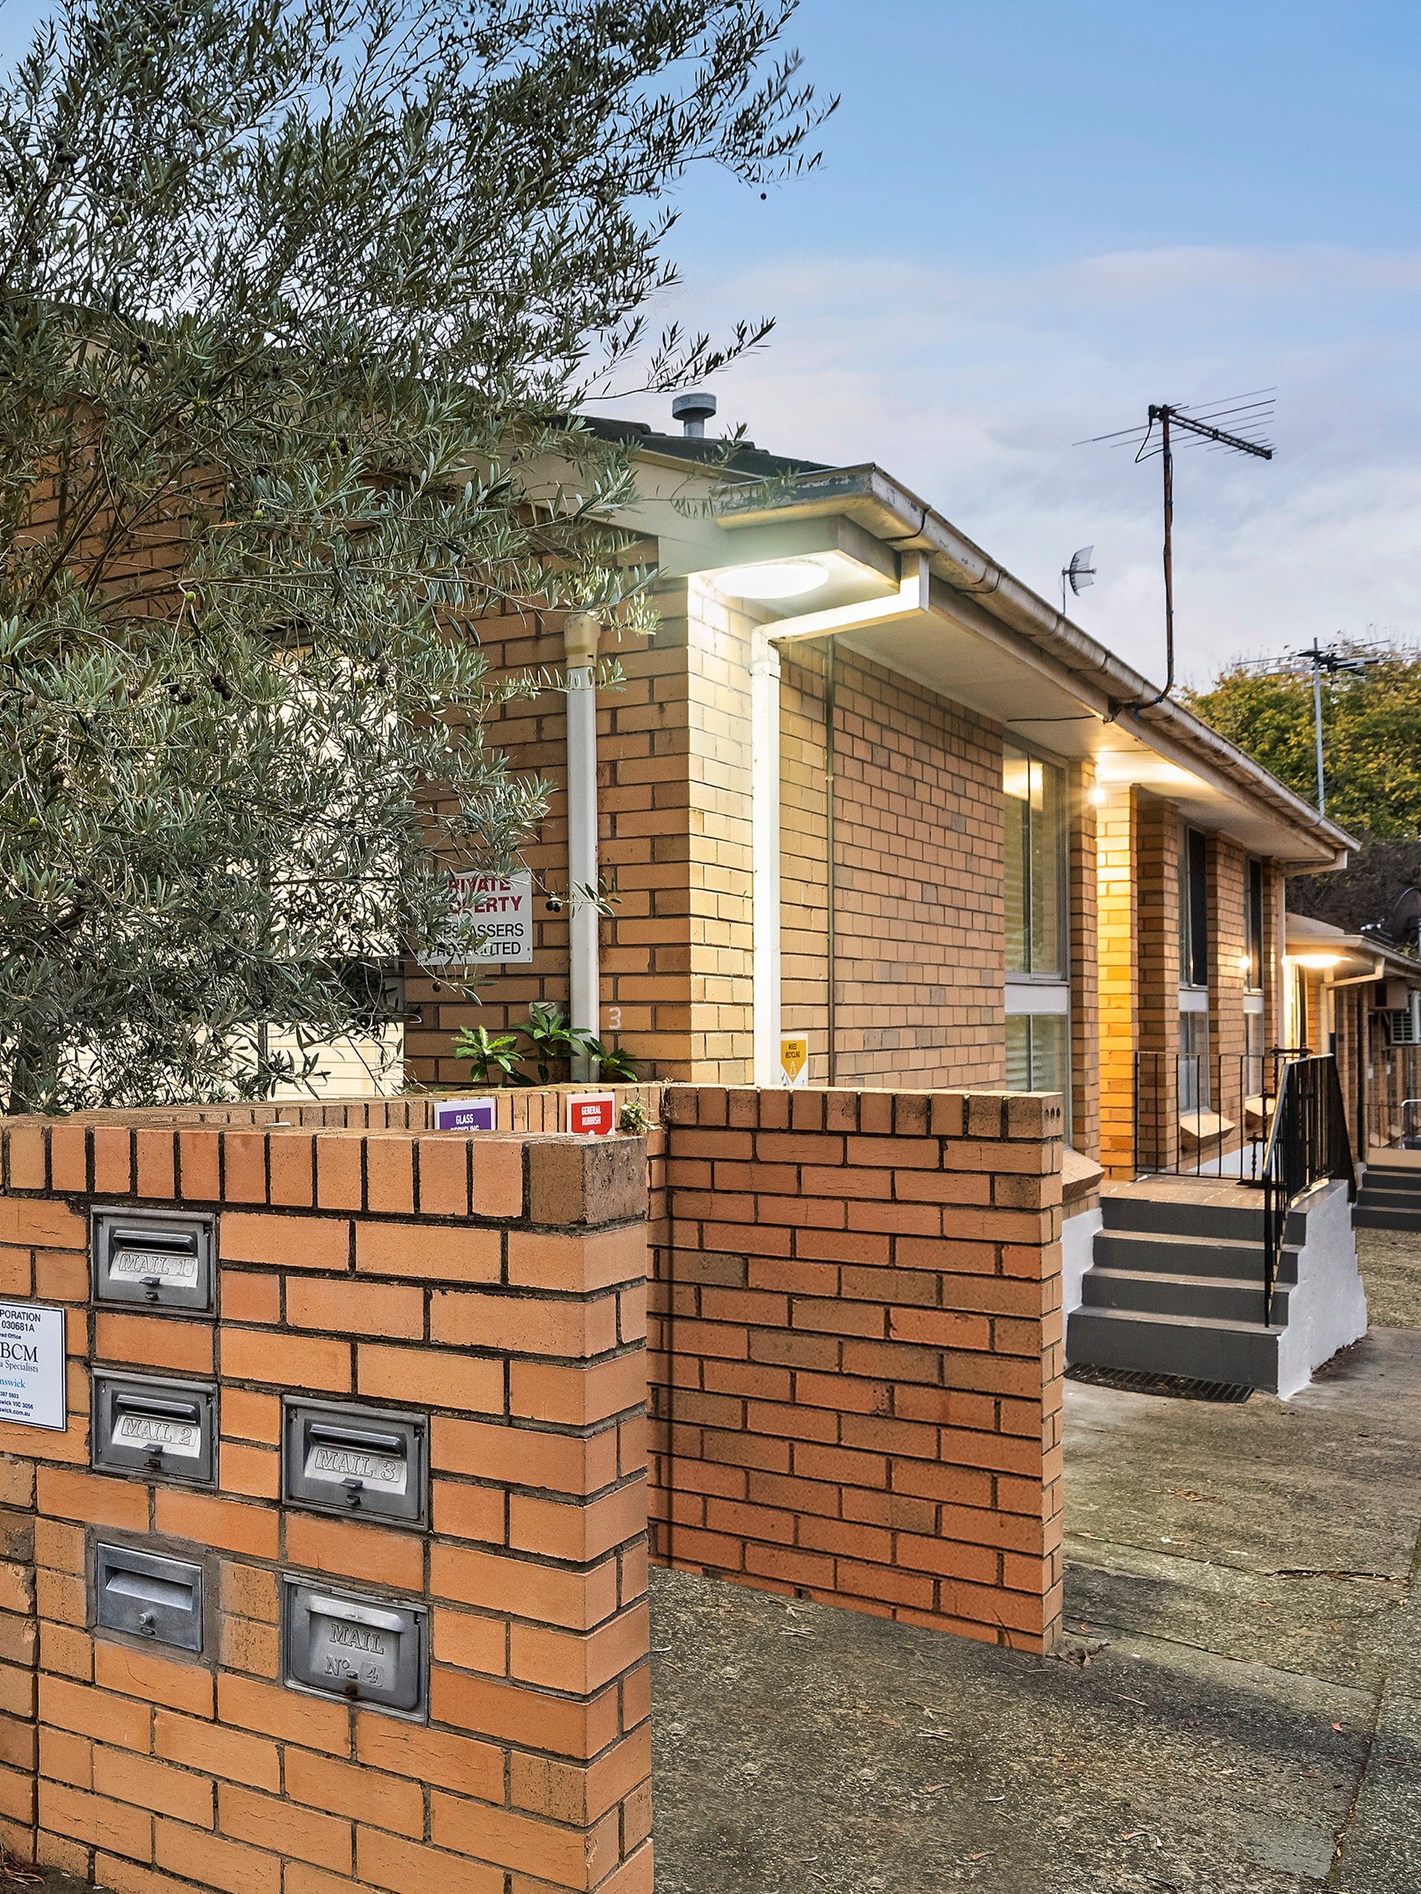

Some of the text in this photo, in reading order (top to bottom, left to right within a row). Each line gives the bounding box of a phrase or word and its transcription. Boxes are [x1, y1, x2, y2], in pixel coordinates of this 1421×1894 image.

[446, 876, 511, 894] RIVATE
[608, 1006, 622, 1030] 3
[455, 1113, 474, 1125] GLASS
[581, 1105, 601, 1115] GENERAL
[119, 1254, 170, 1275] MAIL
[1, 1320, 36, 1333] 030681A
[8, 1332, 22, 1340] Office
[5, 1359, 40, 1373] Specialists
[121, 1417, 193, 1445] MAIL 2
[315, 1449, 396, 1480] MAIL 3
[329, 1622, 385, 1655] MAIL
